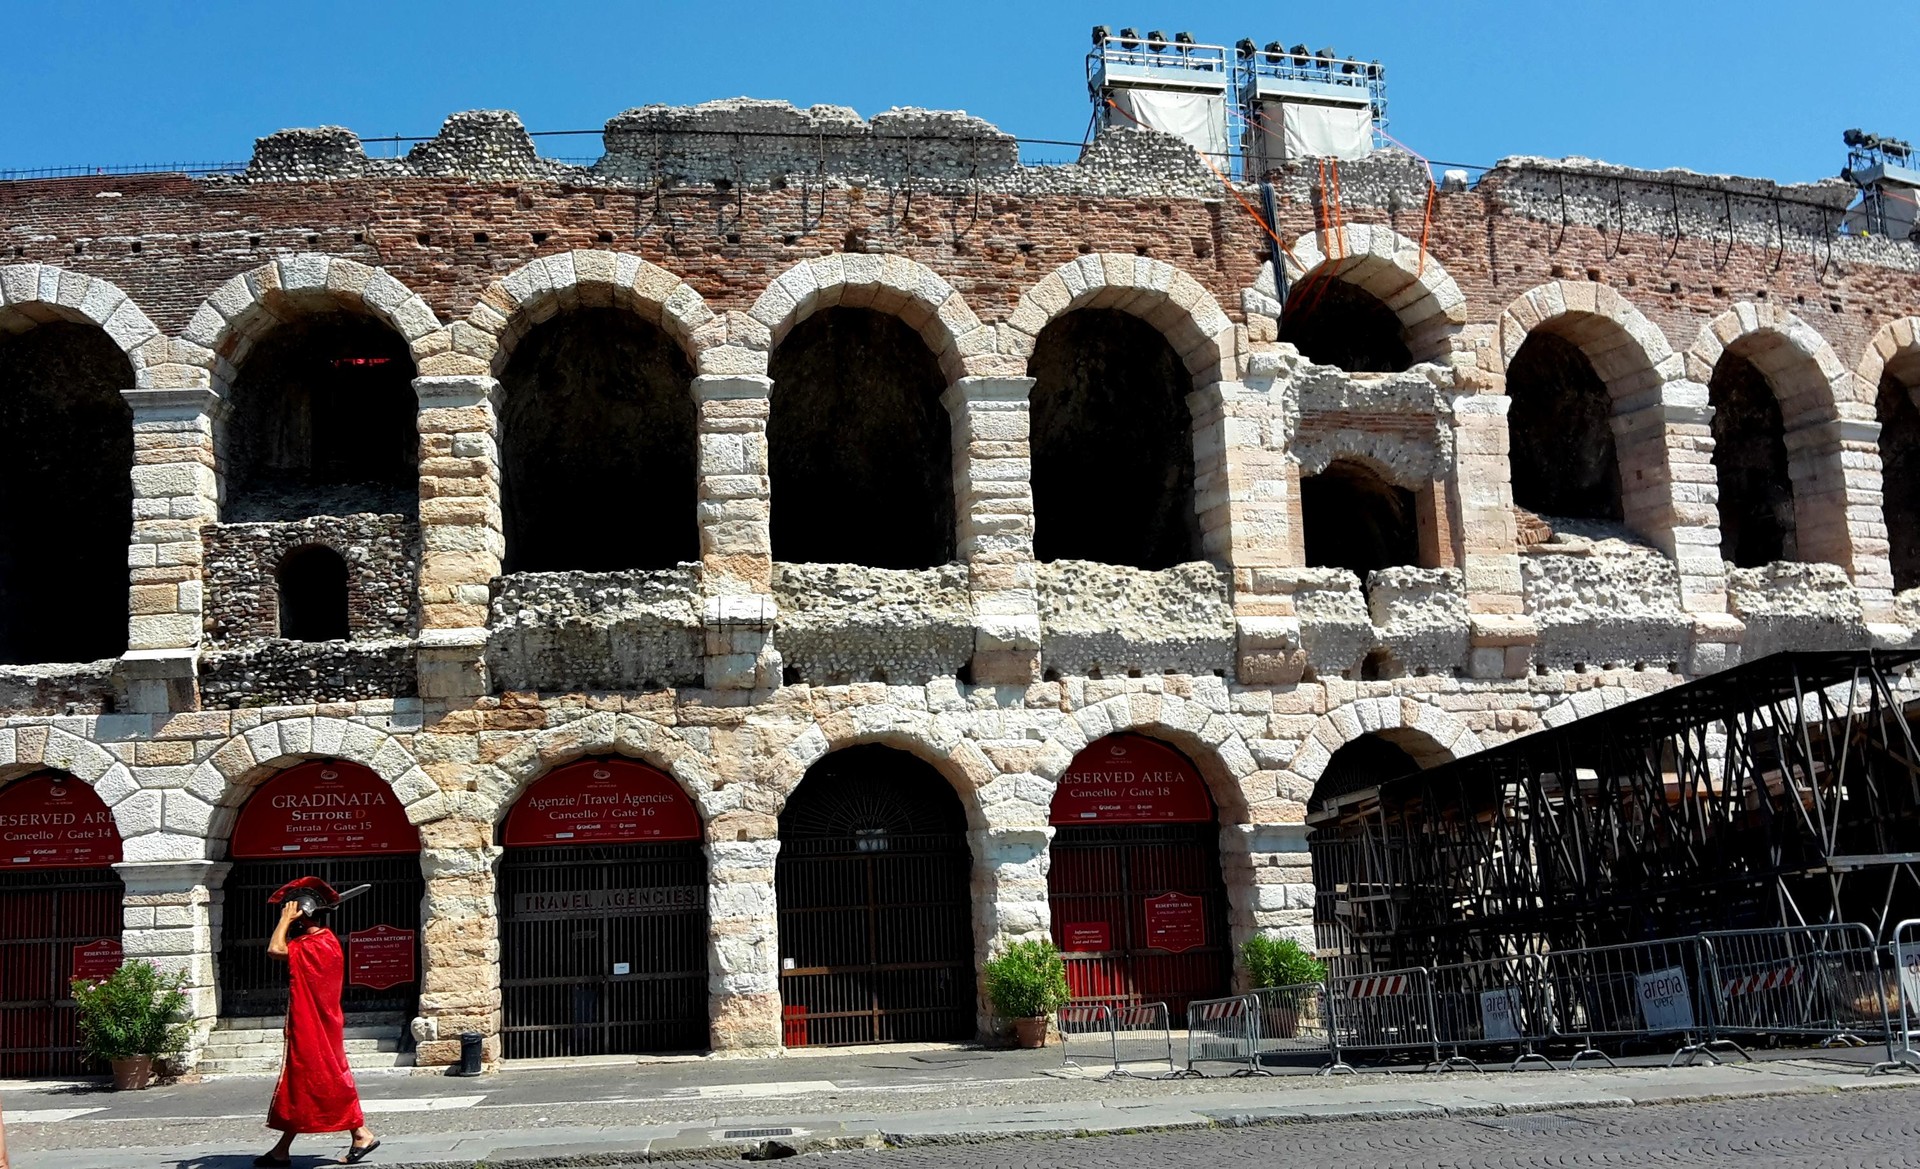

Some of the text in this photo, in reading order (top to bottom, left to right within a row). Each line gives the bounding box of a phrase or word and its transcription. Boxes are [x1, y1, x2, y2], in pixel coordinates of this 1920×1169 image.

[1142, 771, 1185, 783] AREA
[1070, 788, 1117, 798] Cancello
[1129, 787, 1154, 797] Gate
[1157, 786, 1170, 796] 18
[272, 792, 386, 809] GRADINATA
[622, 792, 674, 808] Agencies
[0, 811, 117, 827] ESERVED ARE
[355, 809, 366, 819] D
[549, 809, 598, 820] Cancello
[612, 808, 638, 818] Gate
[641, 806, 655, 817] 16
[286, 823, 322, 833] Entrata
[333, 822, 357, 832] Gate
[360, 821, 372, 830] 15
[3, 830, 54, 841] Cancello
[67, 829, 95, 840] Gate
[97, 828, 112, 838] 14
[525, 888, 696, 911] TRAVEL AGENCIES
[1643, 974, 1684, 1001] arena
